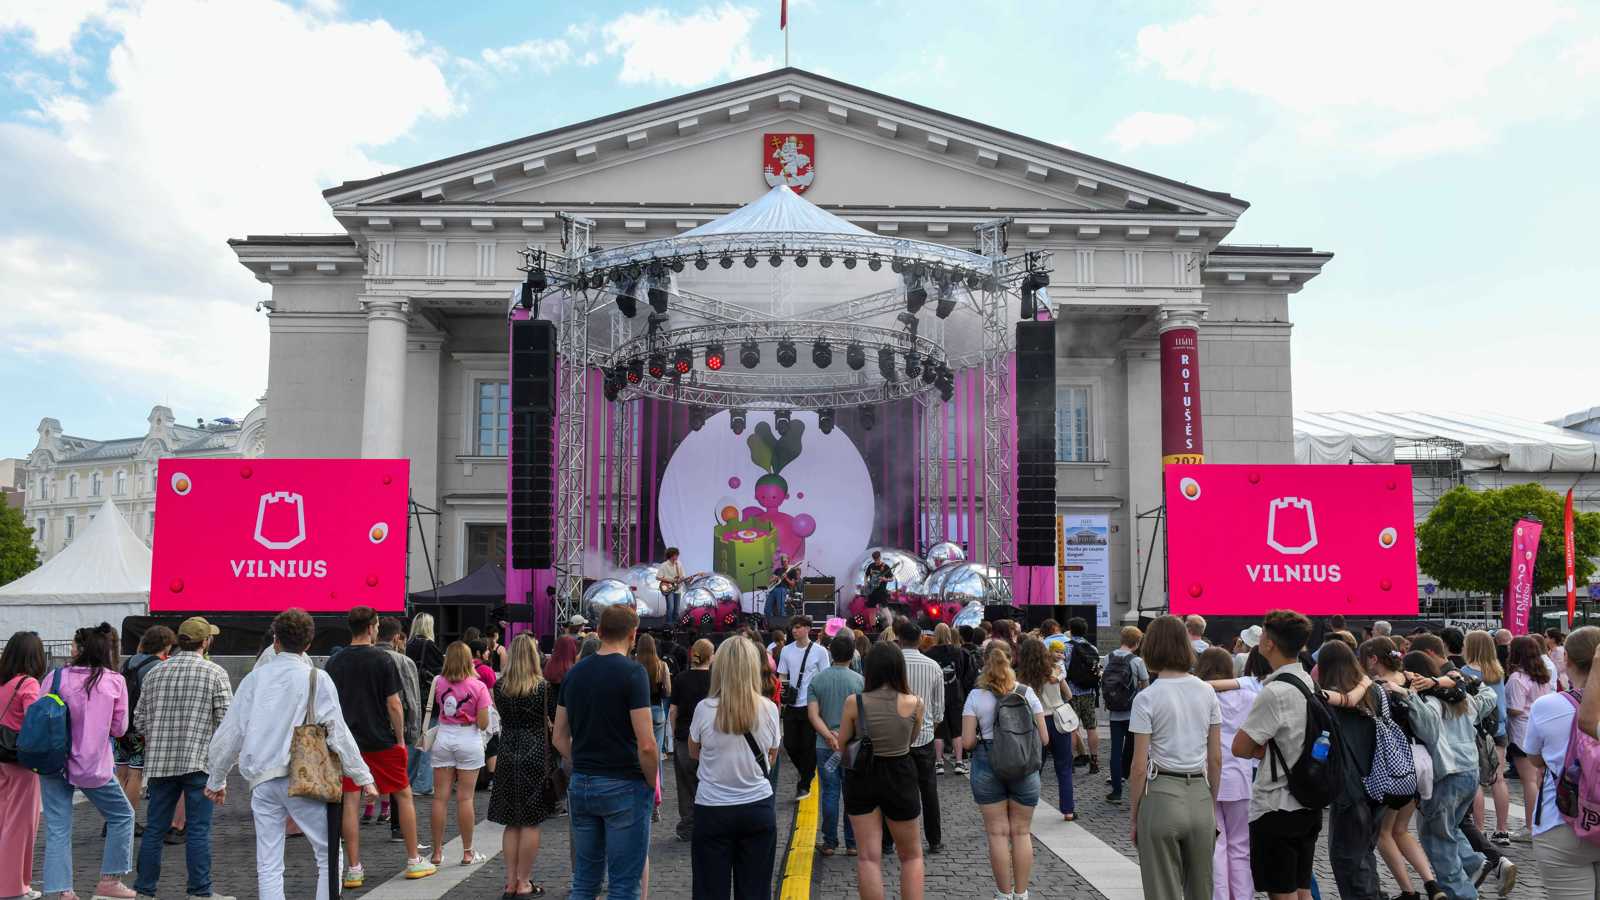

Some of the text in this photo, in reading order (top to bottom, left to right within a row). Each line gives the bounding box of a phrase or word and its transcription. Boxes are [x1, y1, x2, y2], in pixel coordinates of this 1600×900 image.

[1181, 354, 1193, 449] ROTUŠĖS
[230, 559, 328, 578] VILNIUS
[1245, 564, 1342, 583] VILNIUS
